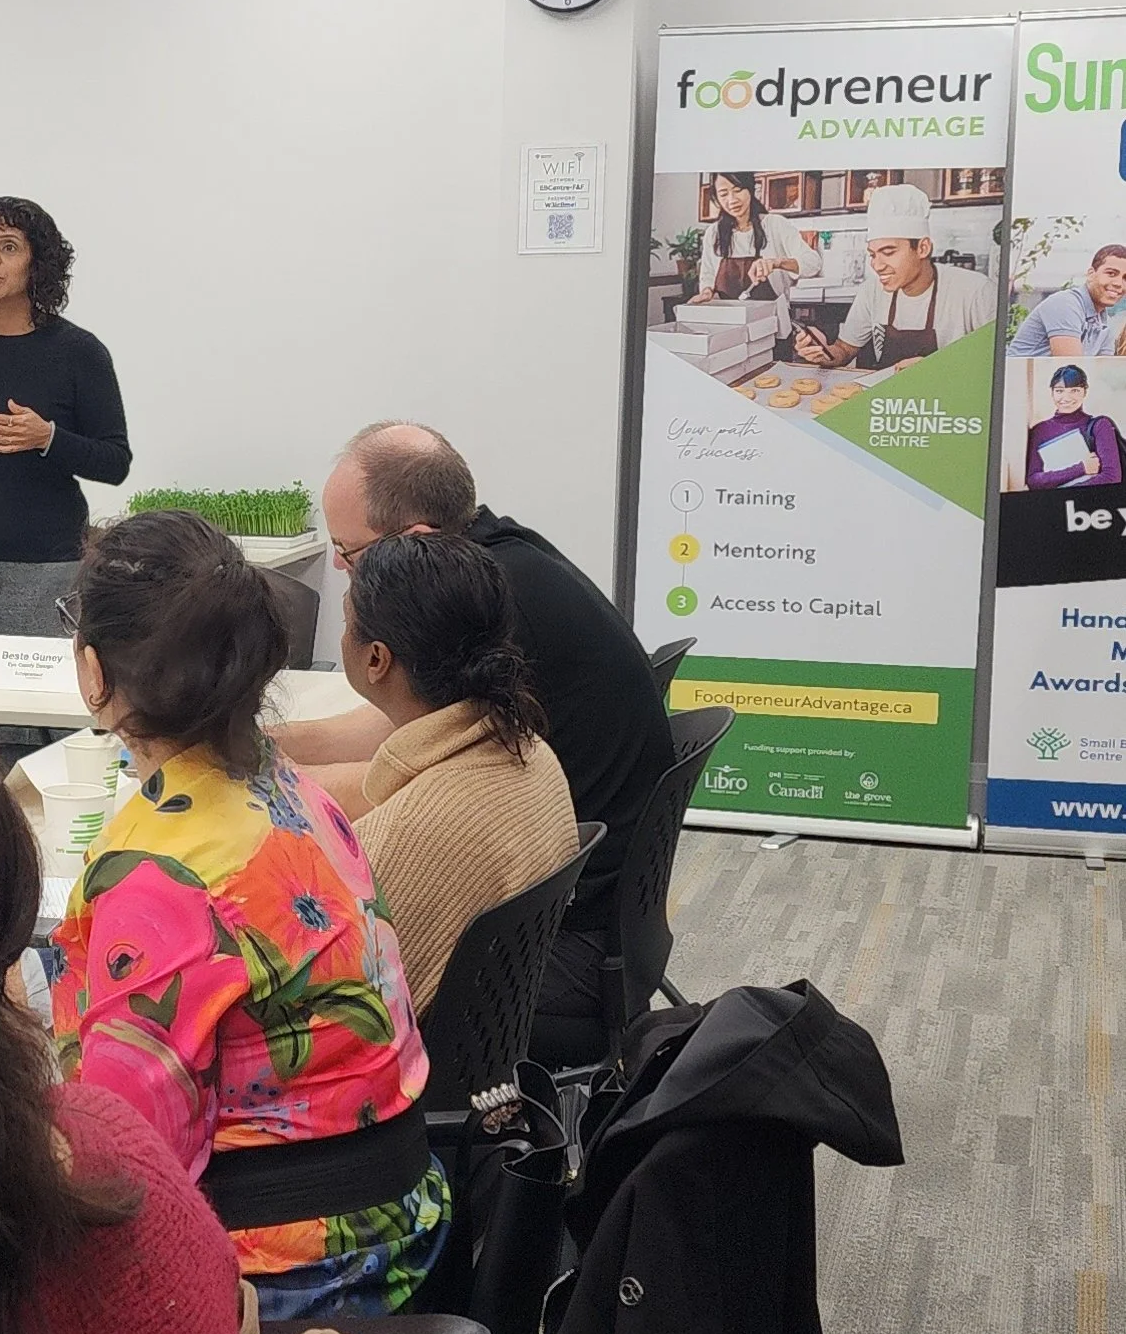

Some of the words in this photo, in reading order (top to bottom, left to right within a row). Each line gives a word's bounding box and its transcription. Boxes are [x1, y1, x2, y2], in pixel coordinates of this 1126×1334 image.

[677, 67, 992, 117] foodpreneur
[797, 116, 985, 139] ADVANTAGE
[870, 398, 946, 415] SMALL
[667, 418, 712, 440] Your
[710, 415, 762, 446] path
[870, 416, 982, 434] BUSINESS
[677, 437, 698, 459] to
[869, 435, 930, 447] CENTRE
[715, 489, 796, 510] Training
[1066, 500, 1113, 532] be
[680, 543, 689, 556] 2
[714, 542, 816, 564] Mentoring
[677, 595, 687, 608] 3
[710, 595, 775, 612] Access
[782, 598, 803, 613] to
[809, 598, 882, 619] Capital
[694, 689, 912, 715] FoodpreneurAdvantage.ca
[744, 743, 774, 753] Funding
[808, 748, 842, 756] provided
[1080, 738, 1116, 749] Small
[1079, 750, 1123, 761] Centre
[705, 772, 748, 790] Libro
[769, 782, 824, 799] Canada
[845, 790, 861, 799] the
[864, 793, 892, 802] grove
